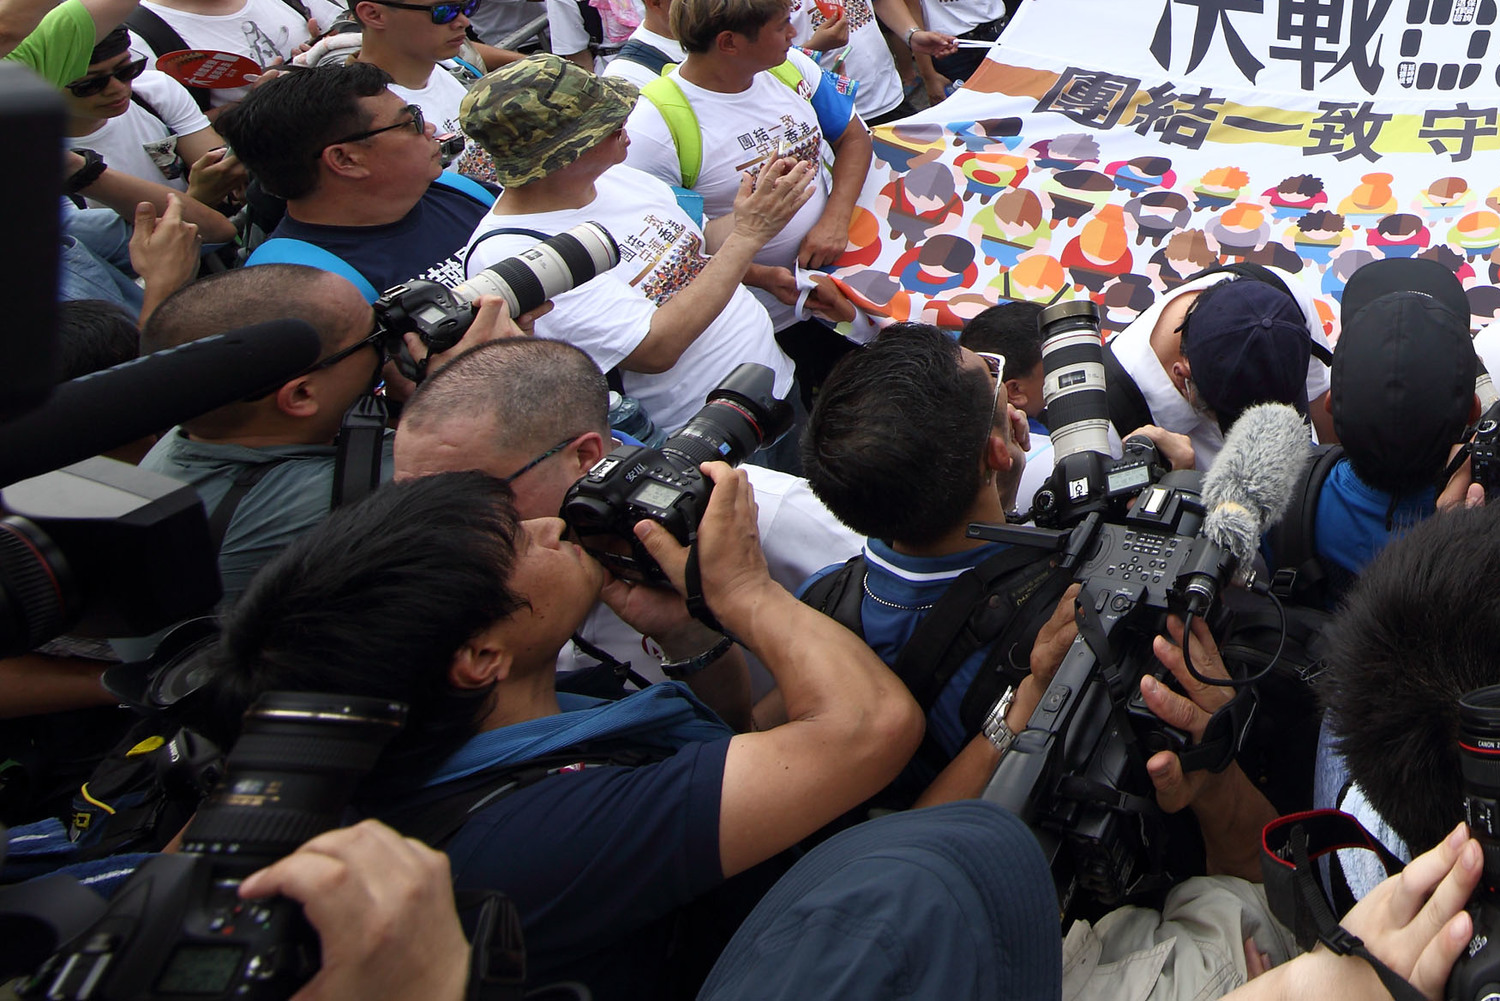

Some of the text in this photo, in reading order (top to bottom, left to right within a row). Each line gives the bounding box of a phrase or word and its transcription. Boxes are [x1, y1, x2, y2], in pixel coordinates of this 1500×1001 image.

[738, 114, 797, 150] 團結一致
[1032, 65, 1394, 164] 團結一致
[1478, 740, 1495, 749] CANON
